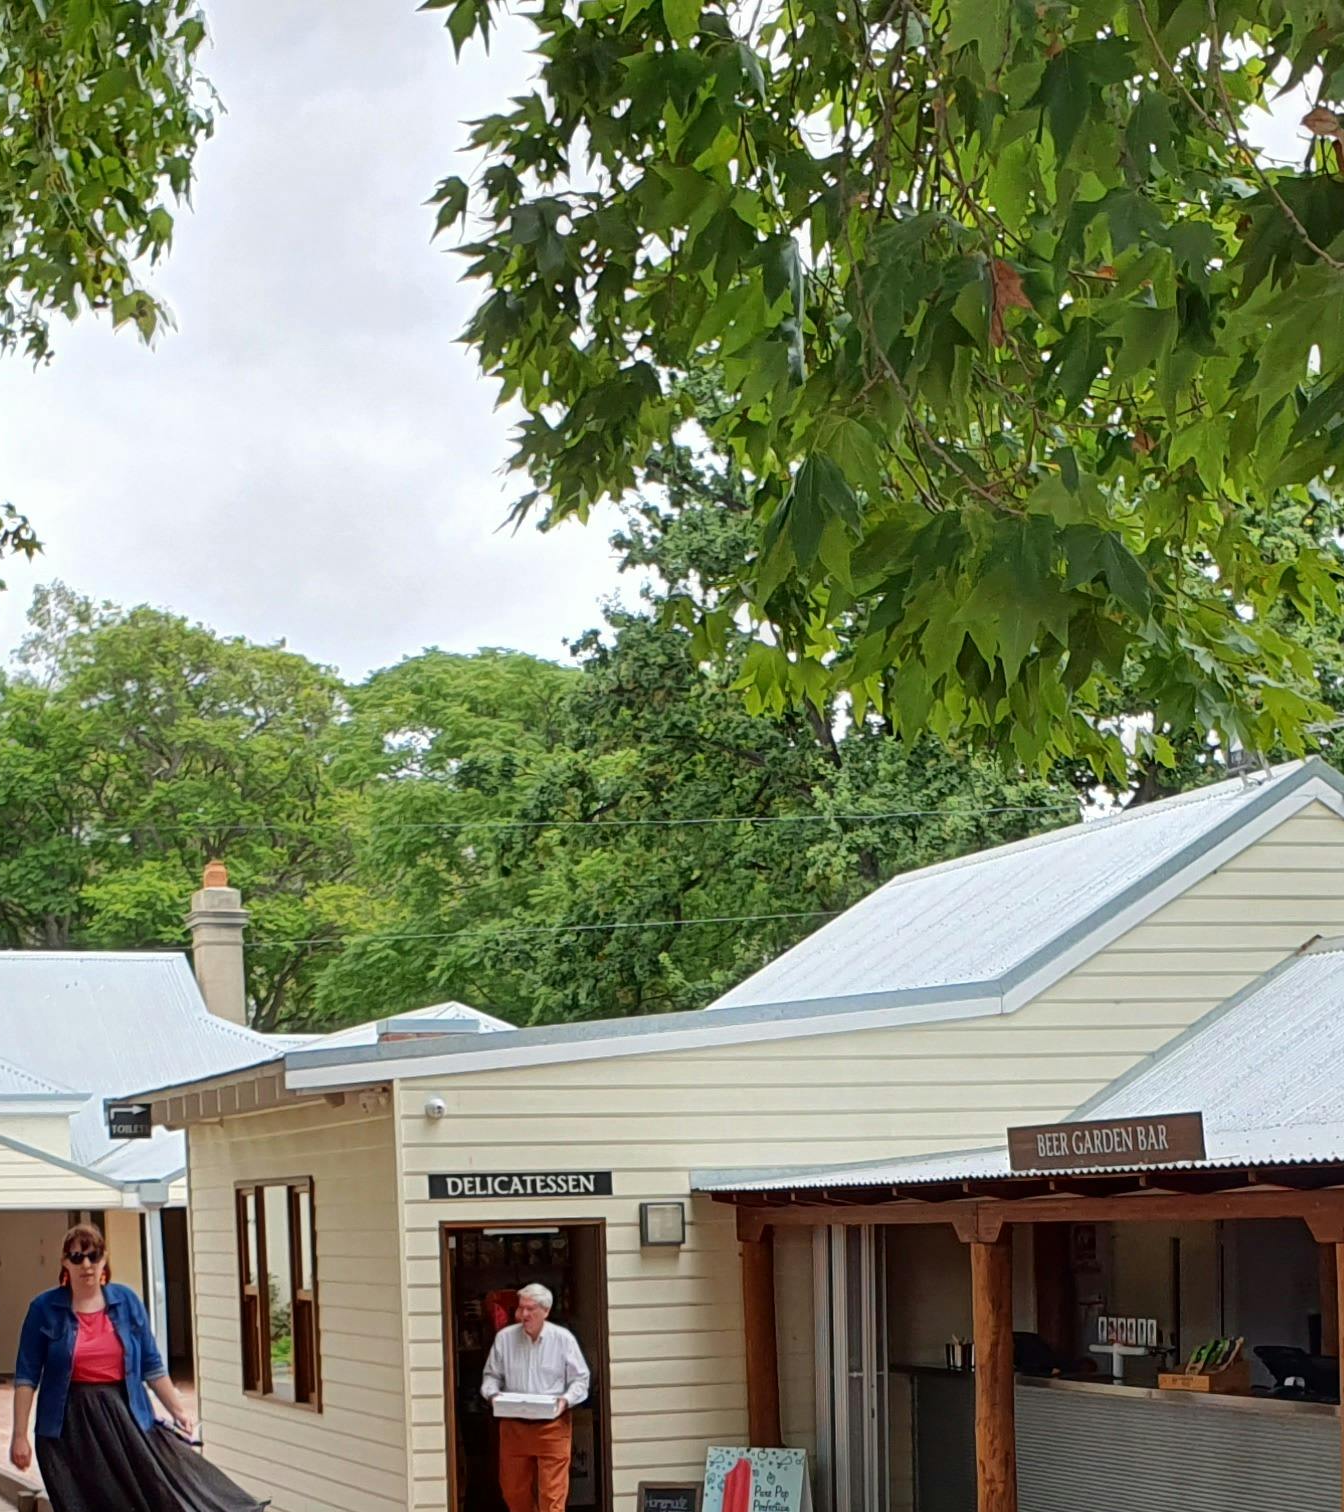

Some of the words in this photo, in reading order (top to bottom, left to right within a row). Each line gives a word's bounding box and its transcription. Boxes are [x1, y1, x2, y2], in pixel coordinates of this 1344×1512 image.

[1036, 1132, 1069, 1157] BEER
[1072, 1127, 1134, 1155] GARDEN
[1137, 1125, 1169, 1151] BAR
[446, 1175, 595, 1196] DELICATESSEN
